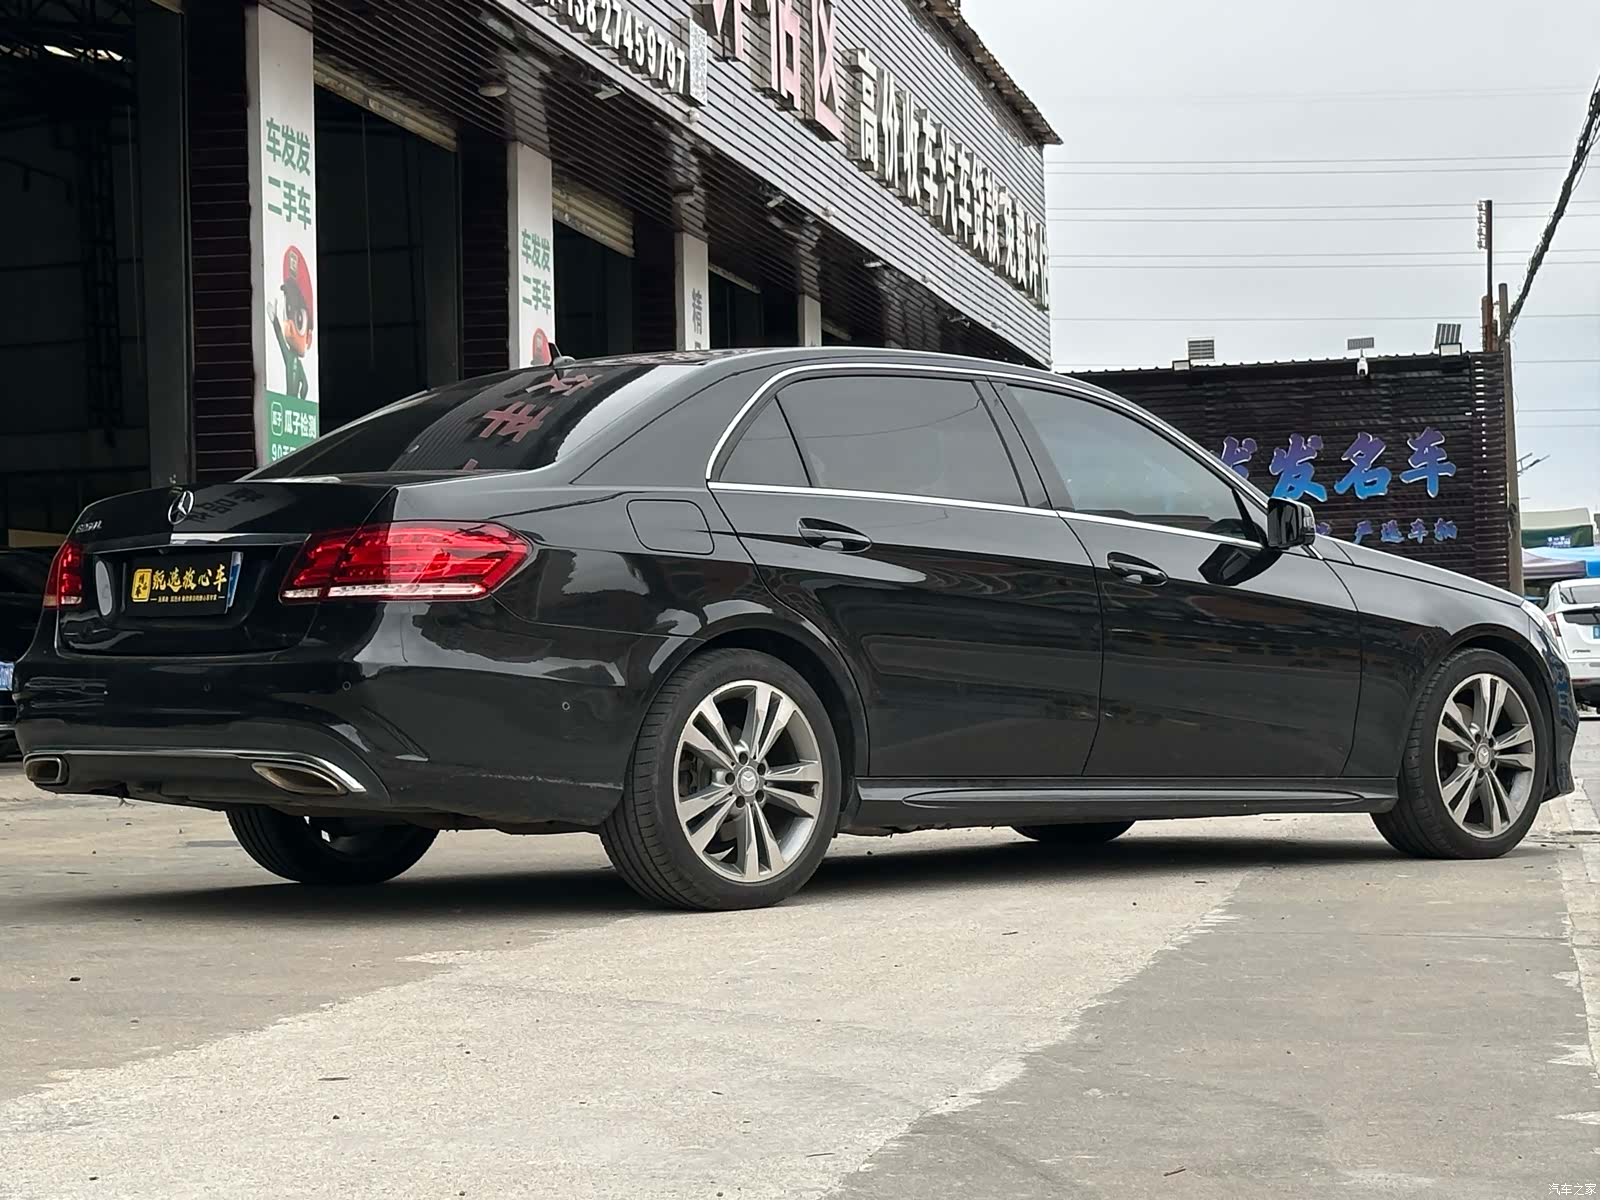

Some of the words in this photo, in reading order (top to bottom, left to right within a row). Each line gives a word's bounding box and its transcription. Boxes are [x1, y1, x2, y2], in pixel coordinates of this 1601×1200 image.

[266, 116, 311, 177] 车发发
[267, 175, 312, 231] 二手车
[521, 228, 551, 273] 车发发
[521, 274, 552, 316] 二手车
[284, 409, 317, 440] 瓜子检测
